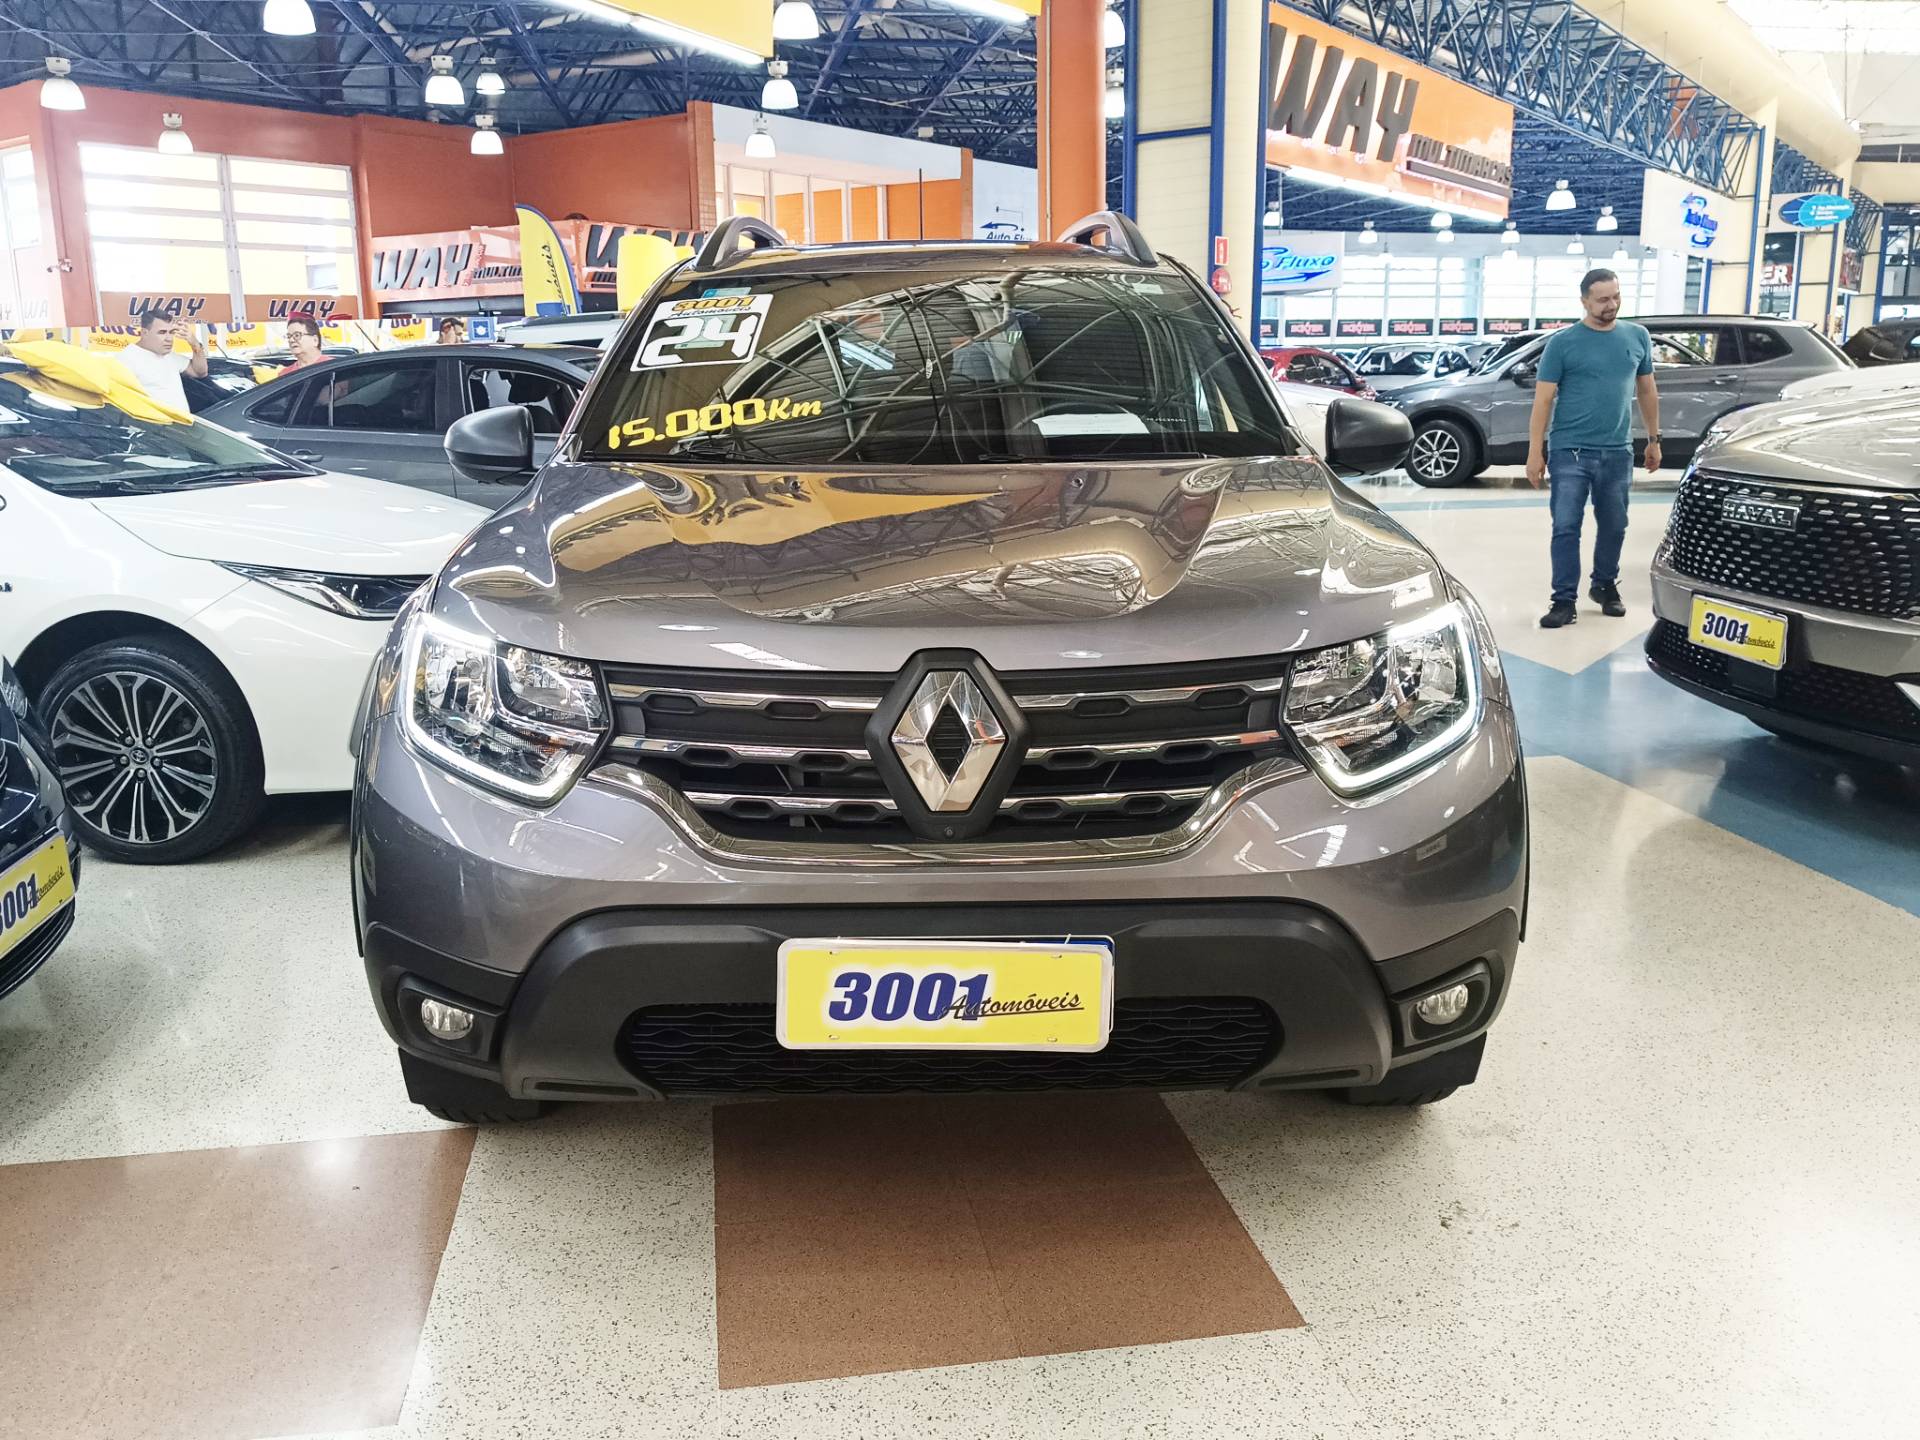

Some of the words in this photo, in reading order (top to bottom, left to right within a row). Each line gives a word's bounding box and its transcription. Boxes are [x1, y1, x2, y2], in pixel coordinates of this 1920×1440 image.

[1269, 22, 1420, 162] WAY
[373, 243, 472, 289] WAY
[1275, 256, 1335, 269] Fluxo
[129, 296, 205, 317] WAY
[269, 299, 336, 319] WAY
[672, 296, 757, 312] 3001
[640, 314, 755, 368] 24
[1723, 502, 1791, 527] HAVAL
[1702, 612, 1749, 645] 3001
[0, 873, 38, 937] 001
[829, 972, 989, 1022] 3001
[936, 991, 1083, 1020] Automóveis
